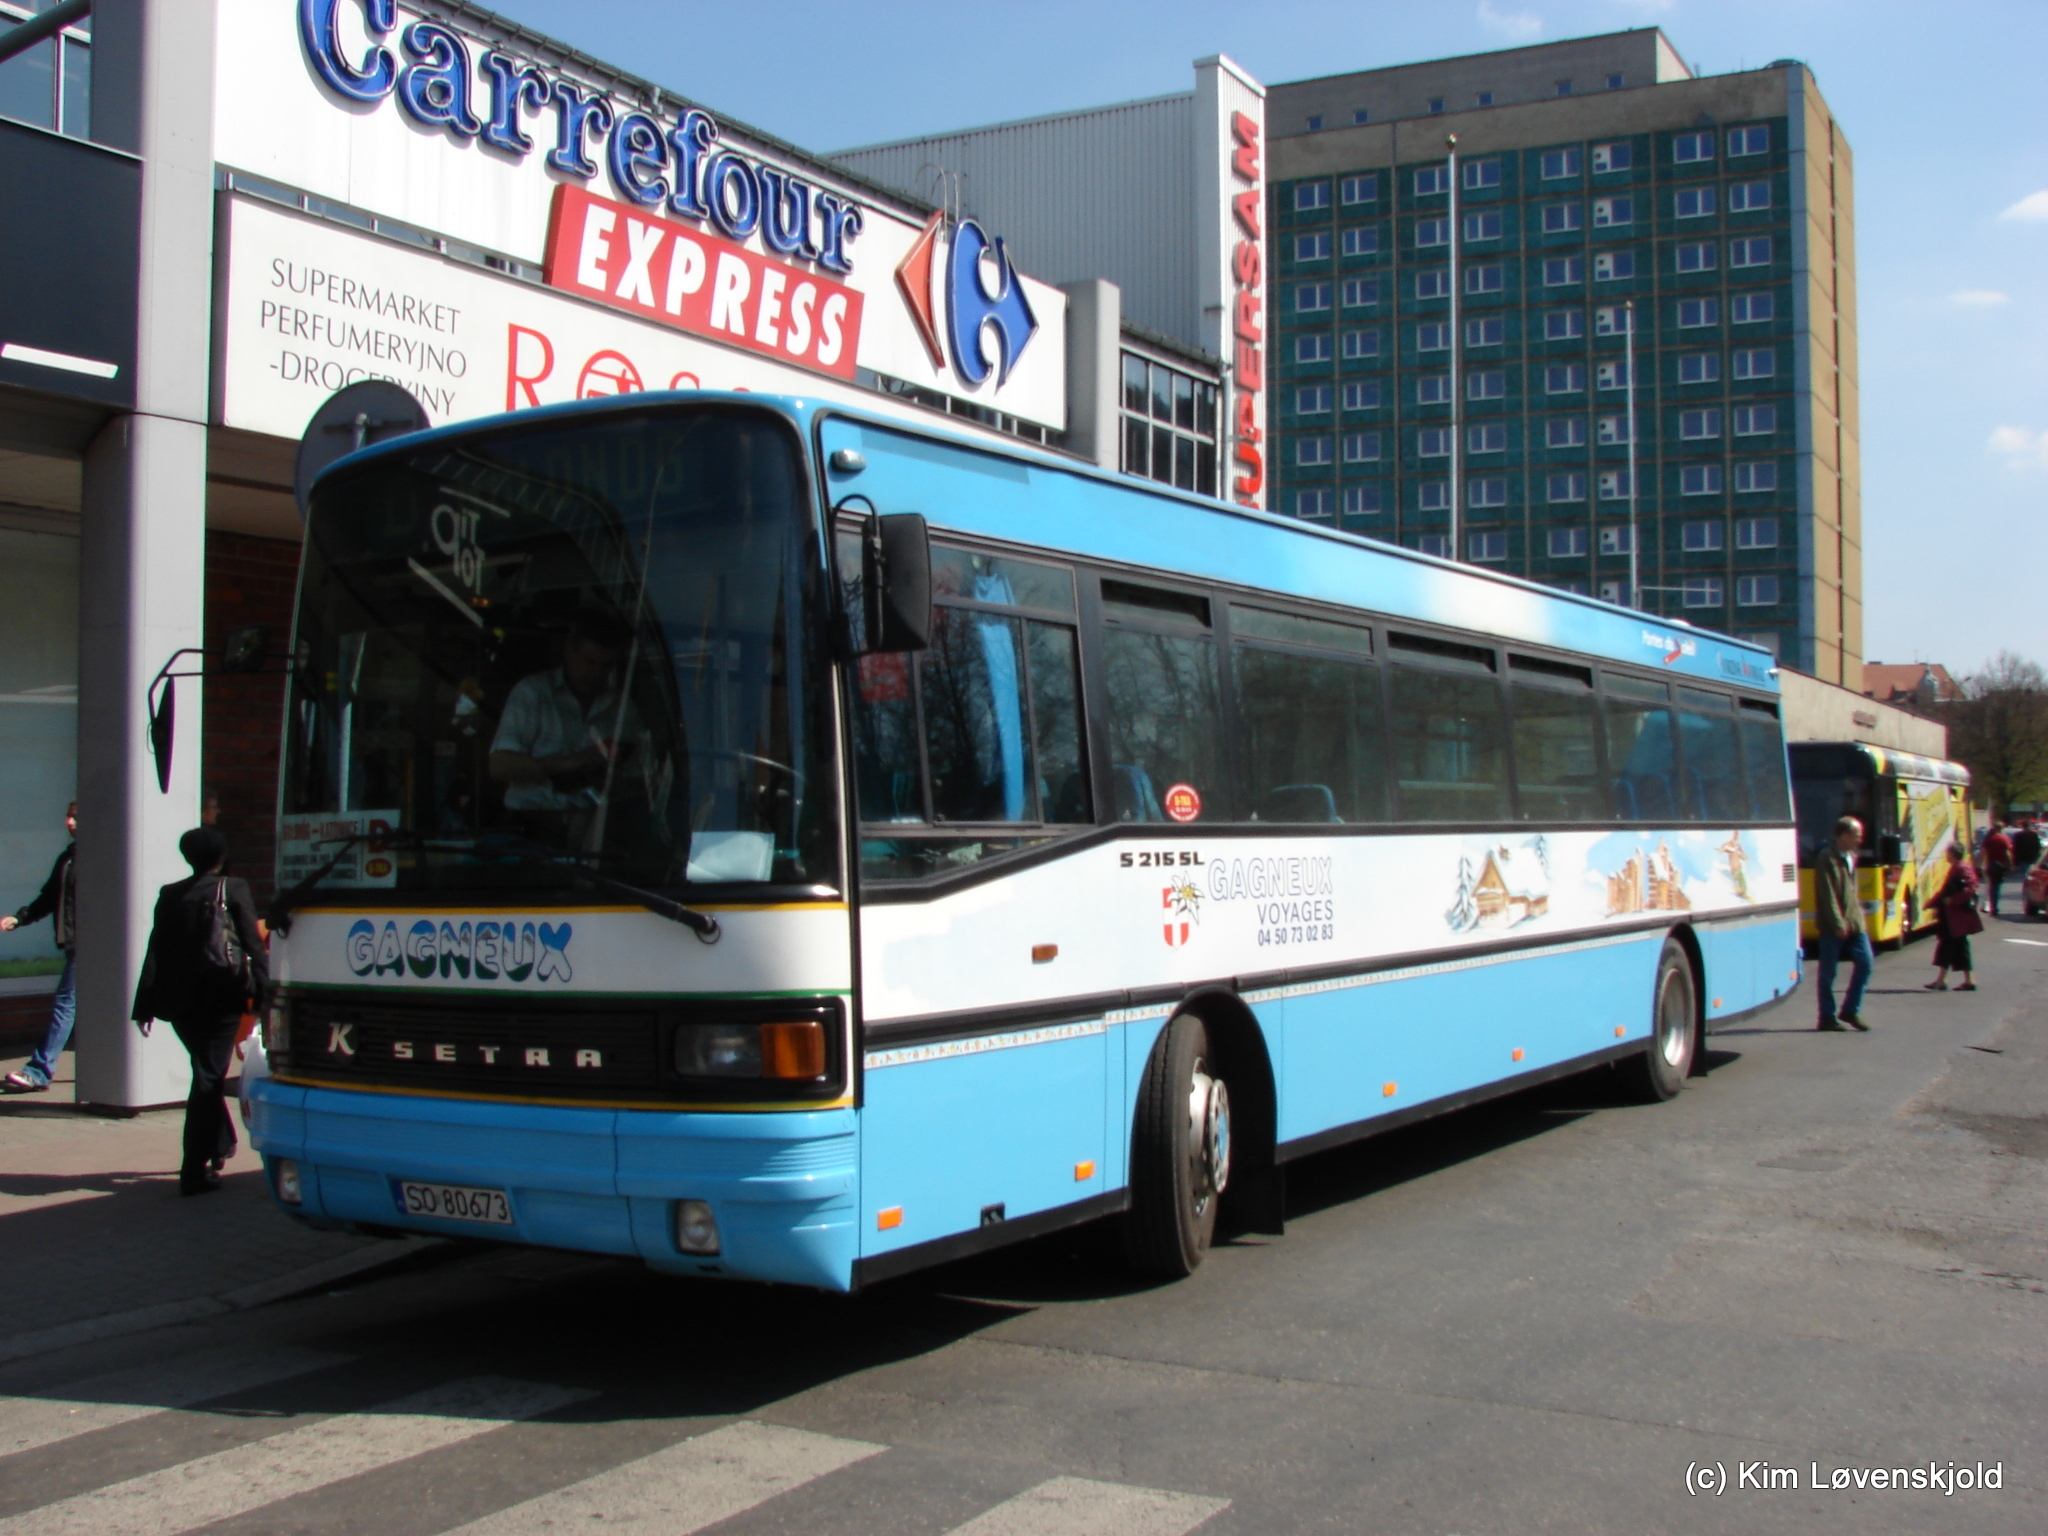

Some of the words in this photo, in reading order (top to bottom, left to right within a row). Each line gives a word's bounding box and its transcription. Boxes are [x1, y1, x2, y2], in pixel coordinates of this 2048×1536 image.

[300, 0, 865, 274] Carrefour
[271, 258, 461, 335] SUPERMARKET
[577, 203, 848, 367] EXPRESS
[1232, 111, 1262, 509] UPERSAM
[261, 300, 467, 378] PERFUMERYJNO
[270, 350, 456, 416] -DROJNY
[1120, 852, 1133, 867] S
[1139, 852, 1175, 867] 215
[1179, 851, 1205, 866] SL
[1208, 857, 1333, 901] GAGNEUX
[1257, 900, 1333, 925] VOYAGES
[1258, 929, 1271, 946] 04
[1275, 928, 1287, 945] 50
[1291, 926, 1303, 944] 73
[1306, 925, 1319, 942] 02
[1321, 923, 1334, 940] 83
[347, 919, 572, 983] GAGNEUX
[393, 1041, 602, 1068] SETRA
[406, 1185, 437, 1212] SO
[442, 1189, 508, 1220] 80673
